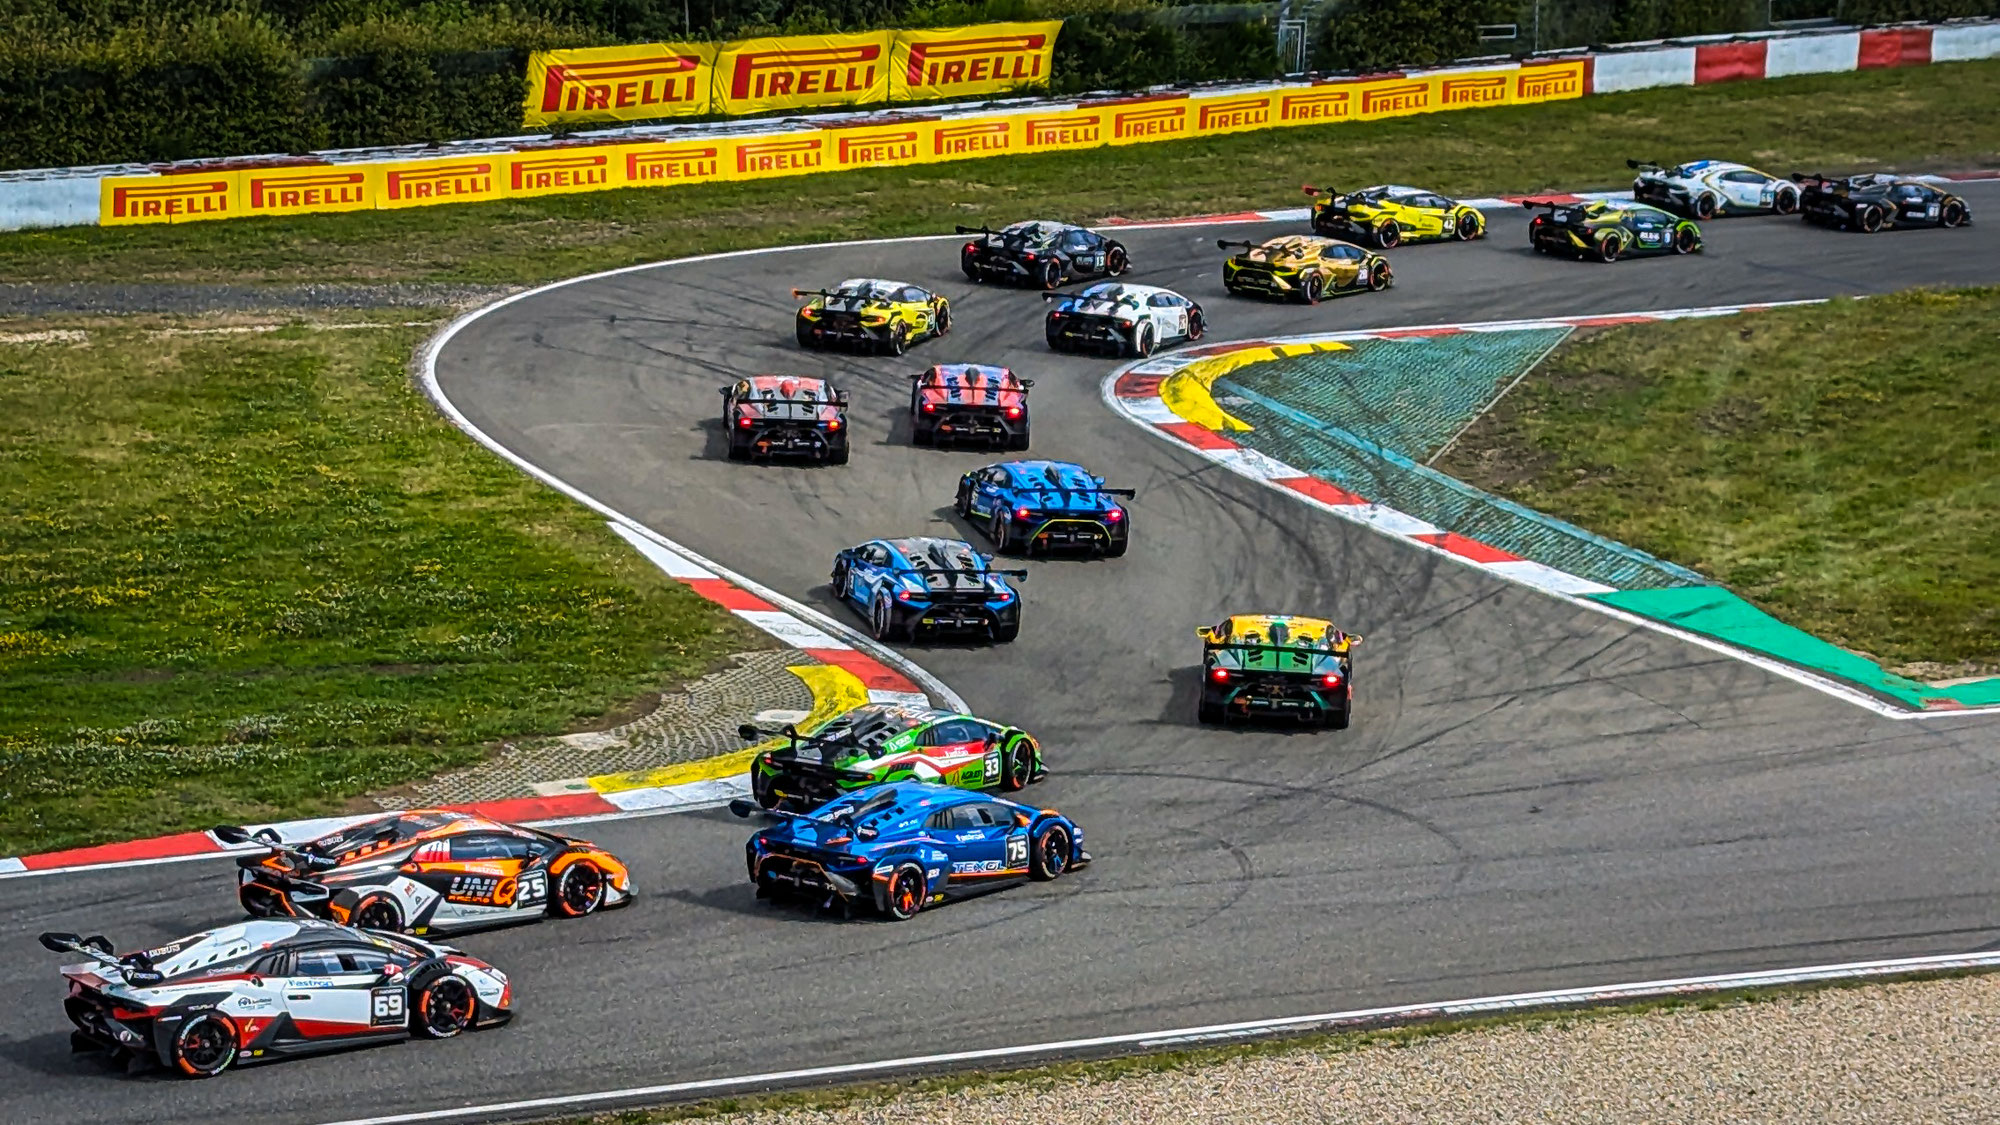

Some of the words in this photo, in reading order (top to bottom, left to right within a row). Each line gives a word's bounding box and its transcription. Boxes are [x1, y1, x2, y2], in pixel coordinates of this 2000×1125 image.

[731, 45, 880, 99] PIRELLI
[907, 34, 1046, 86] PIRELLI
[542, 56, 700, 112] PIRELLI
[1363, 83, 1428, 113] PIRELLI
[1443, 76, 1506, 103] PIRELLI
[1518, 70, 1577, 97] PIRELLI
[1115, 106, 1185, 137] PIRELLI
[1199, 99, 1270, 129] PIRELLI
[1282, 92, 1349, 120] PIRELLI
[935, 123, 1009, 154] PIRELLI
[1027, 115, 1100, 145] PIRELLI
[737, 139, 822, 172] PIRELLI
[839, 132, 917, 163] PIRELLI
[512, 156, 607, 190] PIRELLI
[627, 148, 717, 180] PIRELLI
[251, 173, 364, 208] PIRELLI
[388, 164, 491, 200] PIRELLI
[114, 181, 228, 217] PIRELLI
[985, 758, 999, 777] 33
[1008, 841, 1027, 861] 75
[518, 878, 546, 900] 25
[374, 995, 402, 1017] 69
